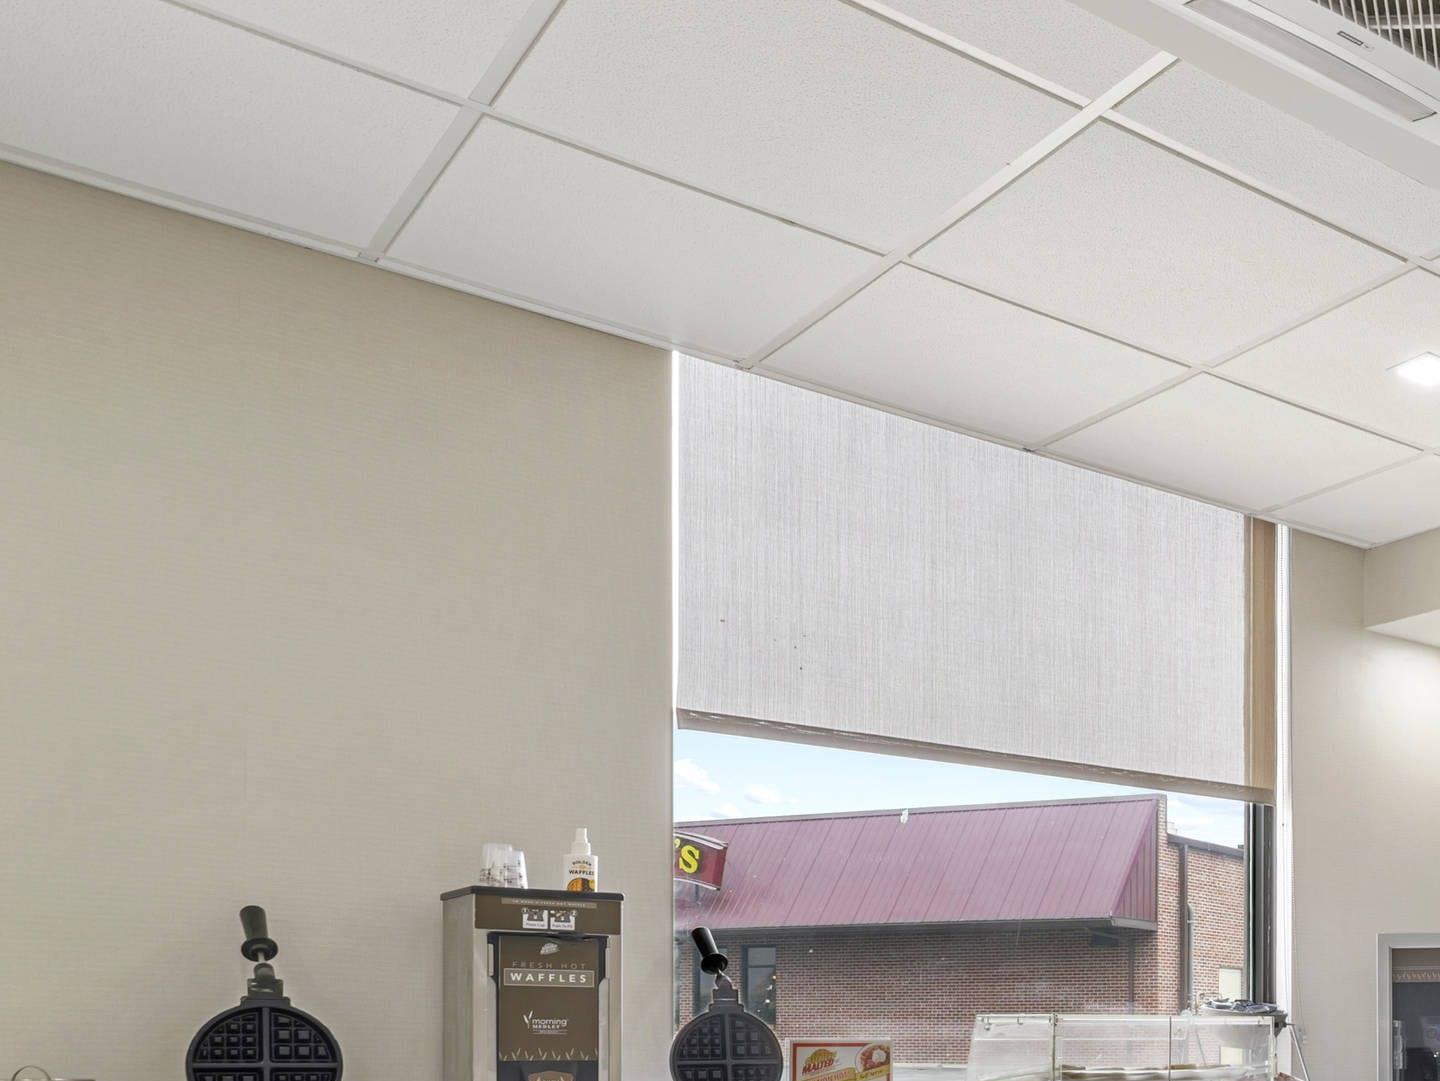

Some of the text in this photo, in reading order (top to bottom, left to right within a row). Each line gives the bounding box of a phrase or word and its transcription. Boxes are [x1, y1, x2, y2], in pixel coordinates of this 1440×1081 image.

[512, 961, 586, 970] FRESH HOT
[510, 972, 587, 983] WAFFLES
[531, 1018, 567, 1027] morning
